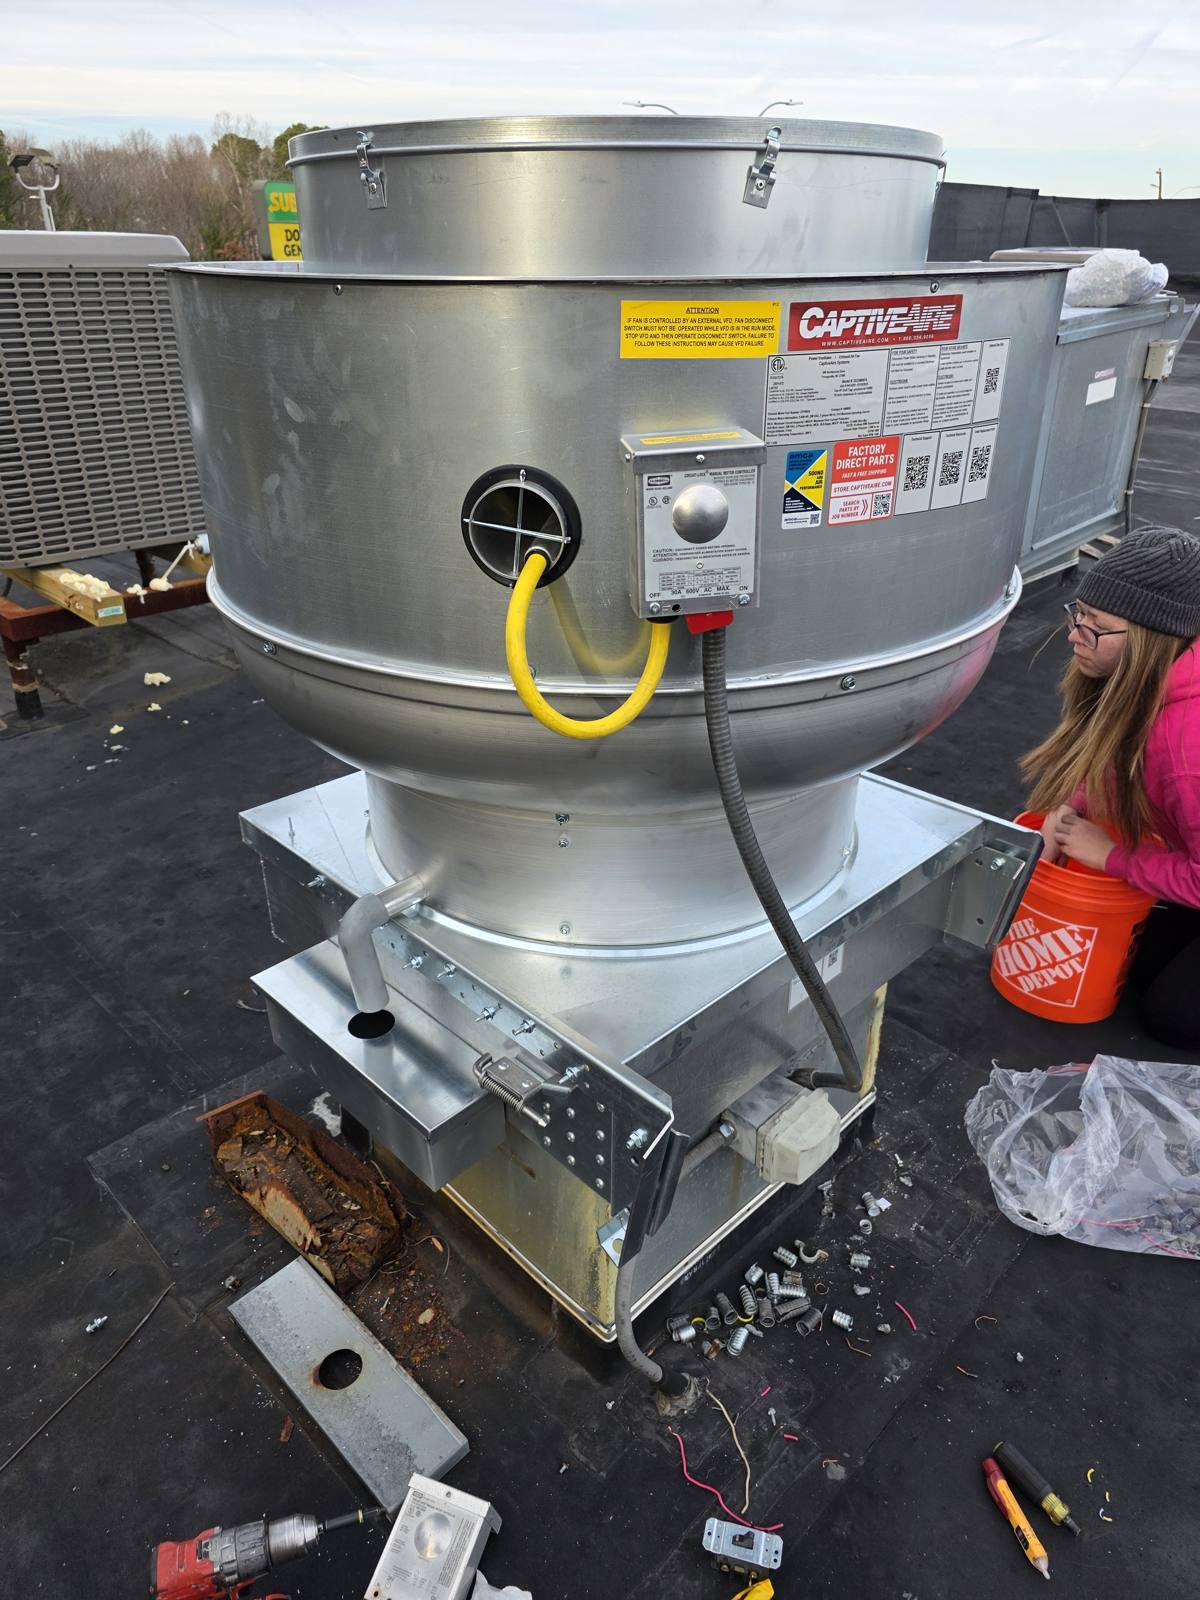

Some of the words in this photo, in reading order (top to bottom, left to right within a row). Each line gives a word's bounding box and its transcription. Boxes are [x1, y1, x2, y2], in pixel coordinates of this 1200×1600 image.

[822, 338, 889, 346] WWW.CAPTIVEAIRE.COM
[848, 444, 886, 457] FACTORY
[836, 457, 867, 470] DIRECT
[868, 454, 894, 466] PARTS
[1008, 918, 1040, 942] THE
[1017, 957, 1084, 993] DEPOT
